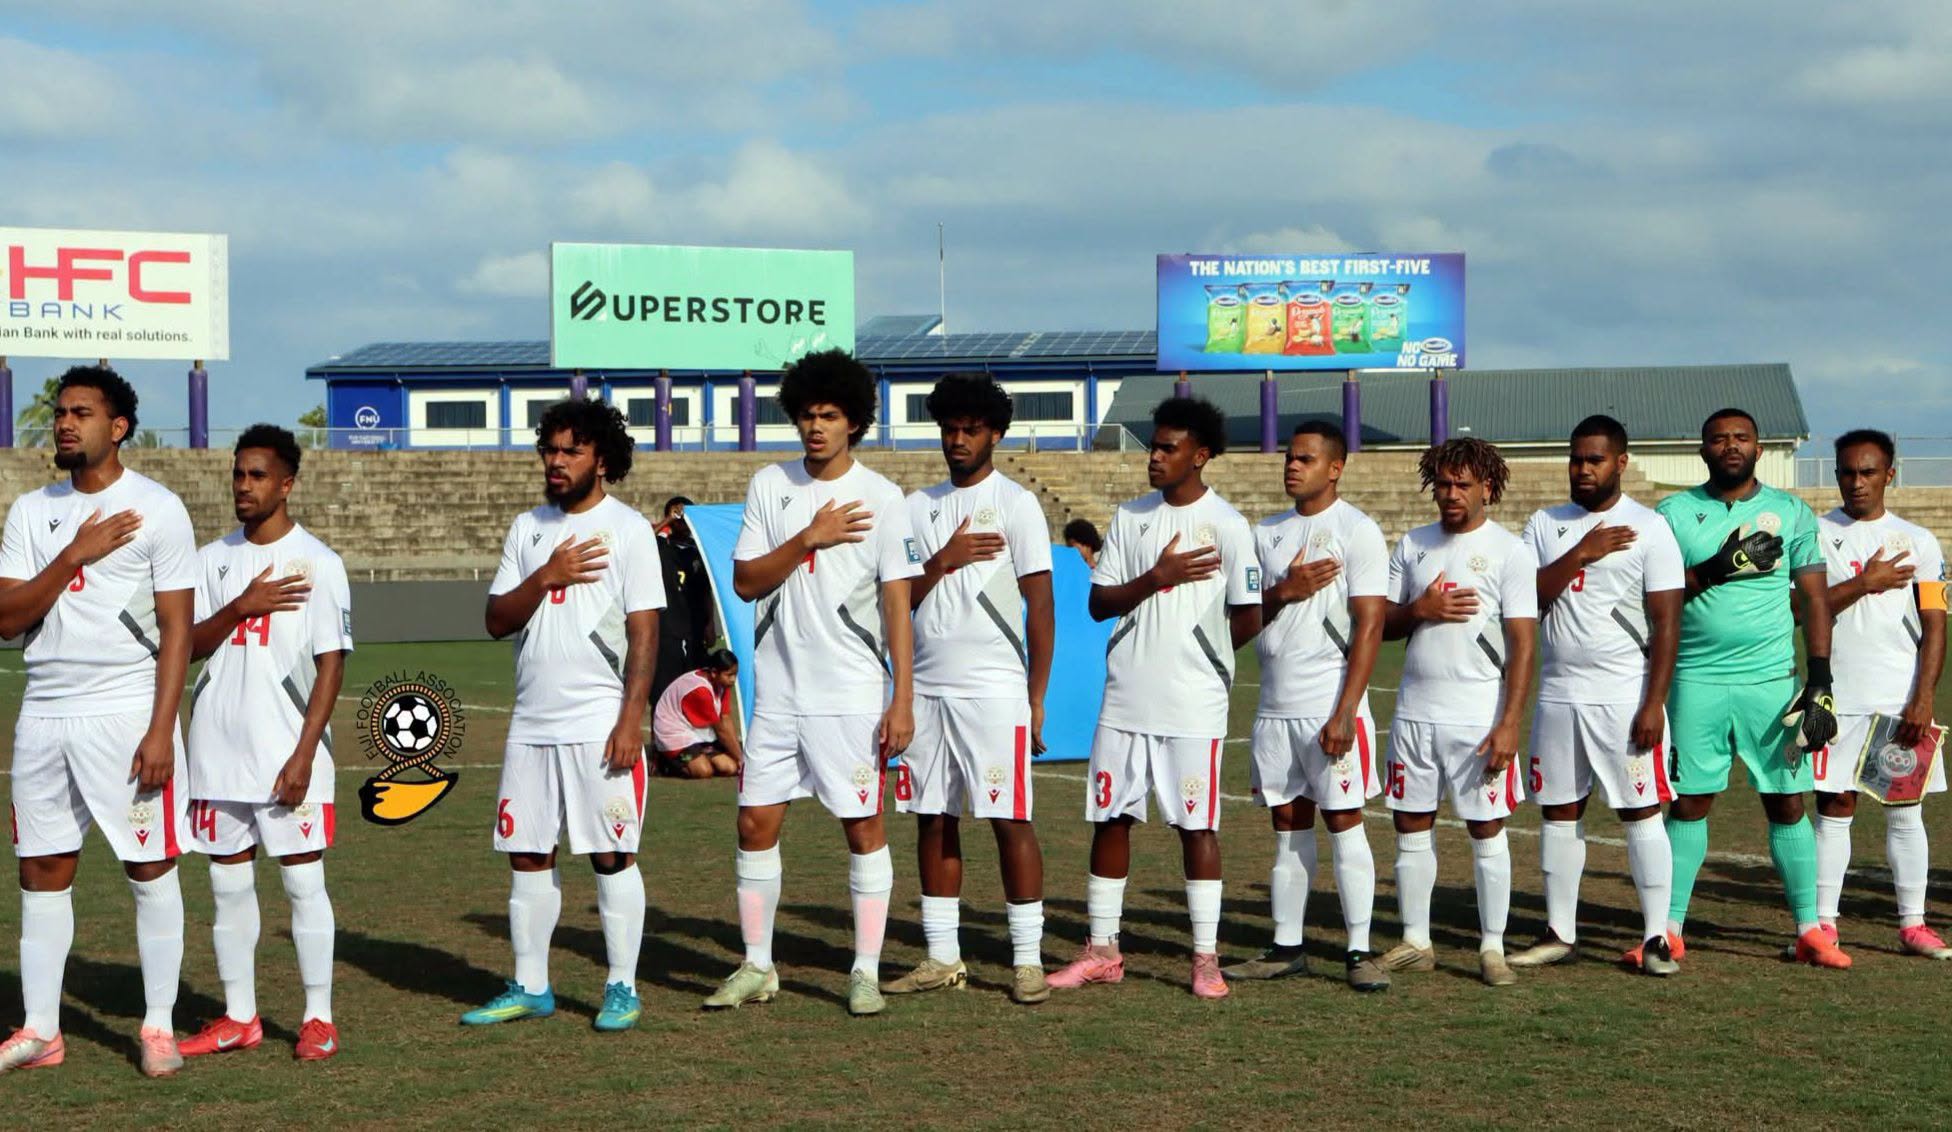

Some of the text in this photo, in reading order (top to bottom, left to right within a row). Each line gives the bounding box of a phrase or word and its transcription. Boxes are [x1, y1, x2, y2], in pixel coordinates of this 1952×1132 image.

[8, 246, 192, 304] HFC
[1189, 259, 1430, 276] THE NATION'S BEST FIRST-FIVE
[9, 301, 125, 321] BANK
[24, 326, 58, 339] Bank
[63, 327, 92, 340] with
[96, 328, 122, 341] real
[126, 329, 193, 343] solutions.
[1401, 341, 1421, 354] NO
[1396, 354, 1458, 367] NO GAME
[895, 764, 913, 801] 8
[1095, 770, 1112, 809] 3
[1385, 760, 1406, 800] 15
[1529, 757, 1543, 793] 5
[191, 800, 217, 843] 14
[497, 798, 515, 839] 6
